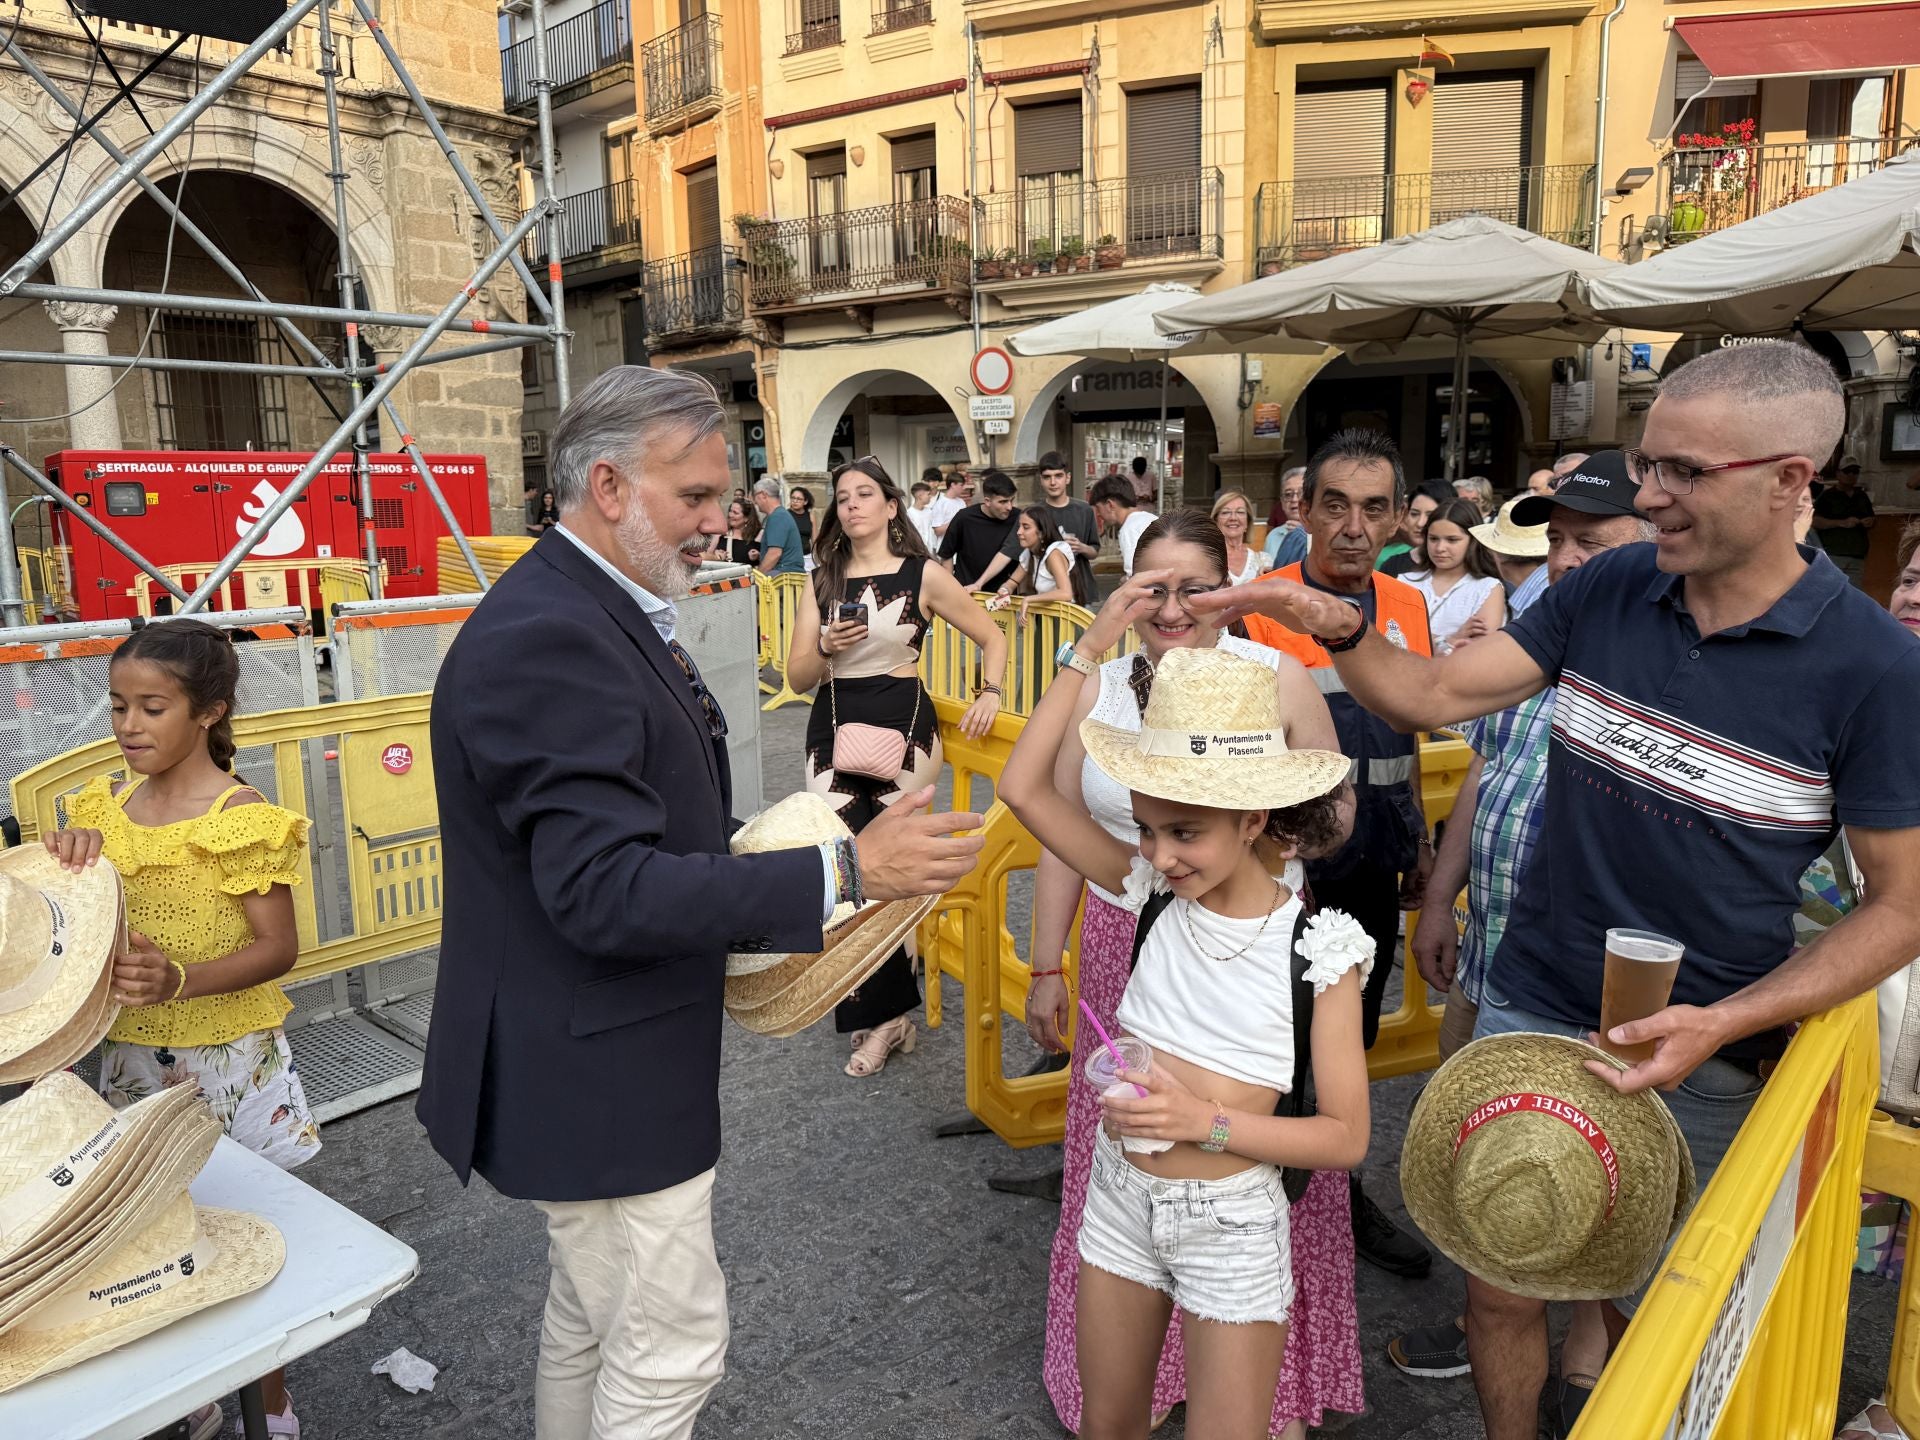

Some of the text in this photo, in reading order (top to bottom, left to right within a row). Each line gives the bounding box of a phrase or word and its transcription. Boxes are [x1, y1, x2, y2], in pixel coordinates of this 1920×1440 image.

[97, 463, 174, 473] SERTRAGUA
[185, 463, 245, 473] ALQUILER
[248, 463, 264, 473] DE
[267, 463, 307, 474] GRUPO
[432, 465, 445, 474] 42
[447, 465, 459, 475] 64
[461, 465, 475, 475] 65
[1573, 473, 1610, 487] Keaton
[1212, 732, 1272, 746] Ayuntamiento de
[1228, 745, 1264, 756] Plasencia
[388, 747, 408, 757] UGT
[1467, 1096, 1522, 1132] AMSTEL
[1531, 1095, 1599, 1138] AMSTEL
[69, 1121, 113, 1164] Ayuntamiento
[91, 1131, 122, 1162] Plasencia
[89, 1263, 175, 1301] Ayuntamiento de
[110, 1283, 162, 1308] Plasencia
